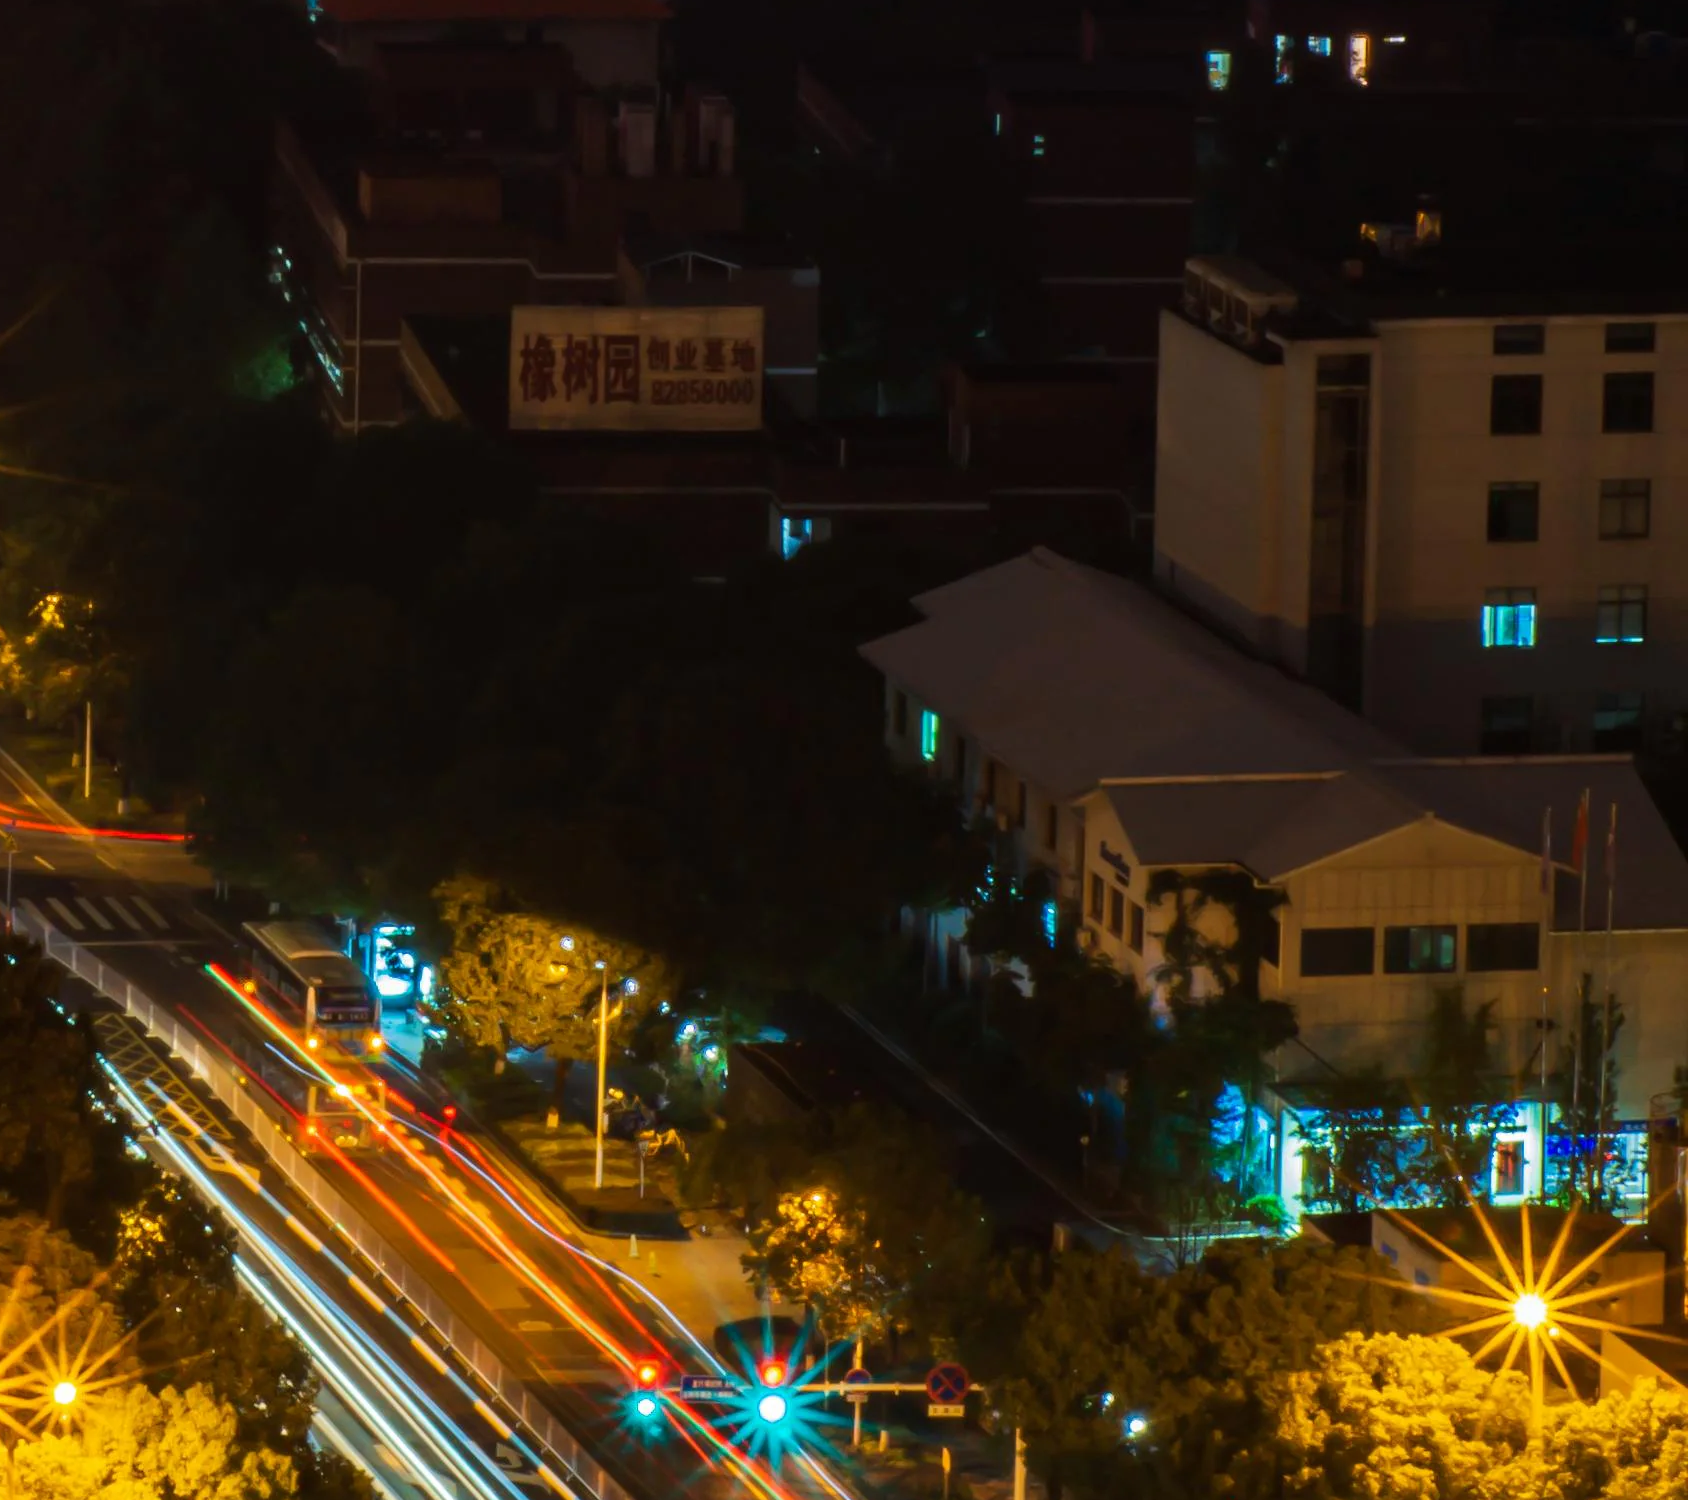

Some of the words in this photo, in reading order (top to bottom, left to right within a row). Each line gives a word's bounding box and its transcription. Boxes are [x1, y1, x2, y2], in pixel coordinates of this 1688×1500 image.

[518, 333, 641, 405] 橡树园
[647, 335, 756, 373] 创业基地
